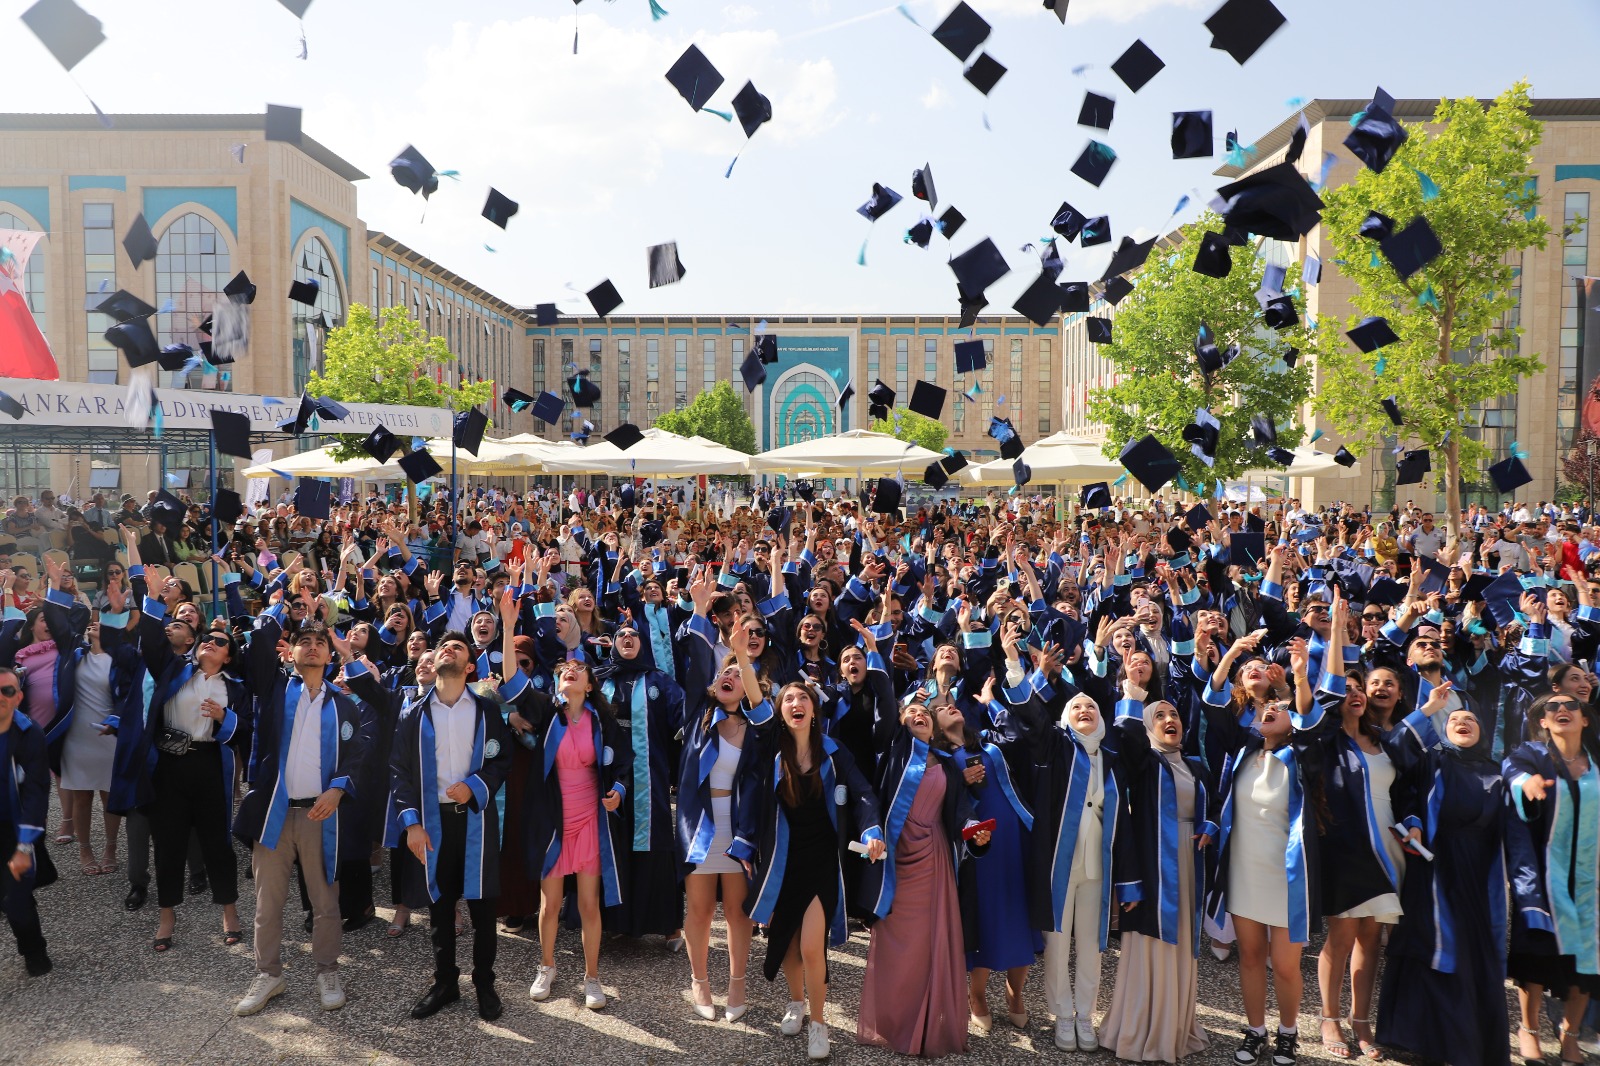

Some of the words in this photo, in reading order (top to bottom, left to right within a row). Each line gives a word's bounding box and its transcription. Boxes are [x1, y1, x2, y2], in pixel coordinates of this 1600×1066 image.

[19, 392, 125, 415] ANKARA
[239, 405, 298, 422] BEYAZ
[321, 411, 419, 428] VERSİTESİ
